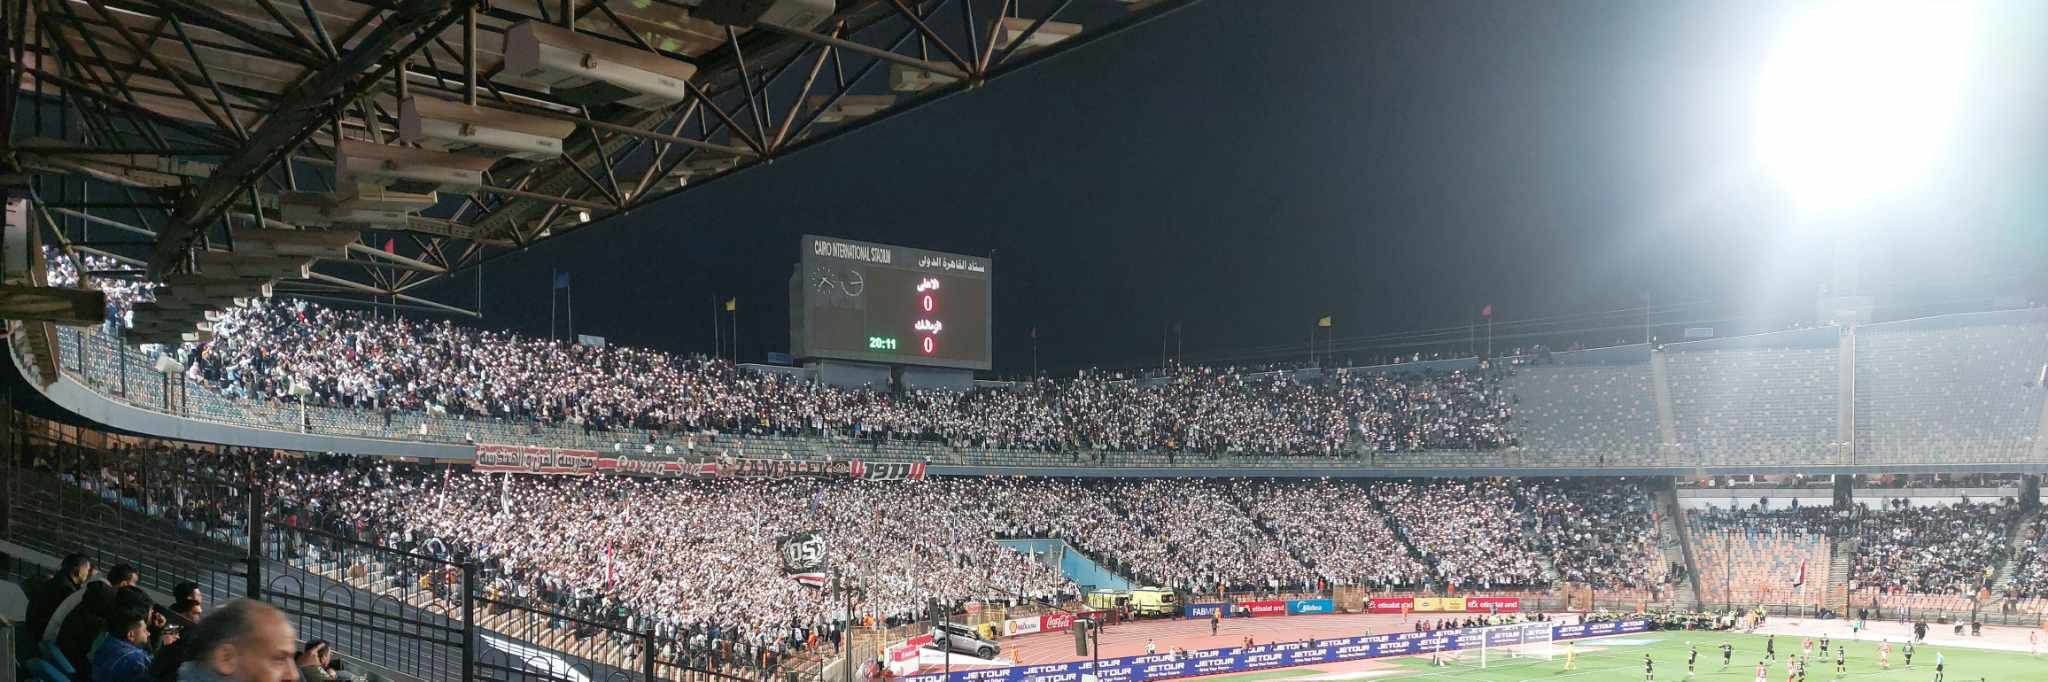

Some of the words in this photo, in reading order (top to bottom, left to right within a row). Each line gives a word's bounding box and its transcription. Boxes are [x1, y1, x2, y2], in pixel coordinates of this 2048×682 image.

[815, 240, 832, 256] CAIRO
[833, 242, 870, 261] INTERNATIONAL
[943, 257, 967, 271] القاهرة
[924, 296, 934, 311] 0
[869, 336, 896, 350] 20:11
[924, 336, 933, 353] 0
[862, 463, 911, 480] 1911
[1317, 639, 1351, 648] JETOUR
[1245, 653, 1282, 663] JETOUR
[1290, 648, 1328, 658] JETOUR
[1144, 662, 1185, 673] JETOUR
[1195, 657, 1234, 668] JETOUR
[963, 669, 1011, 680] JETOUR
[1023, 664, 1068, 675] JETOUR
